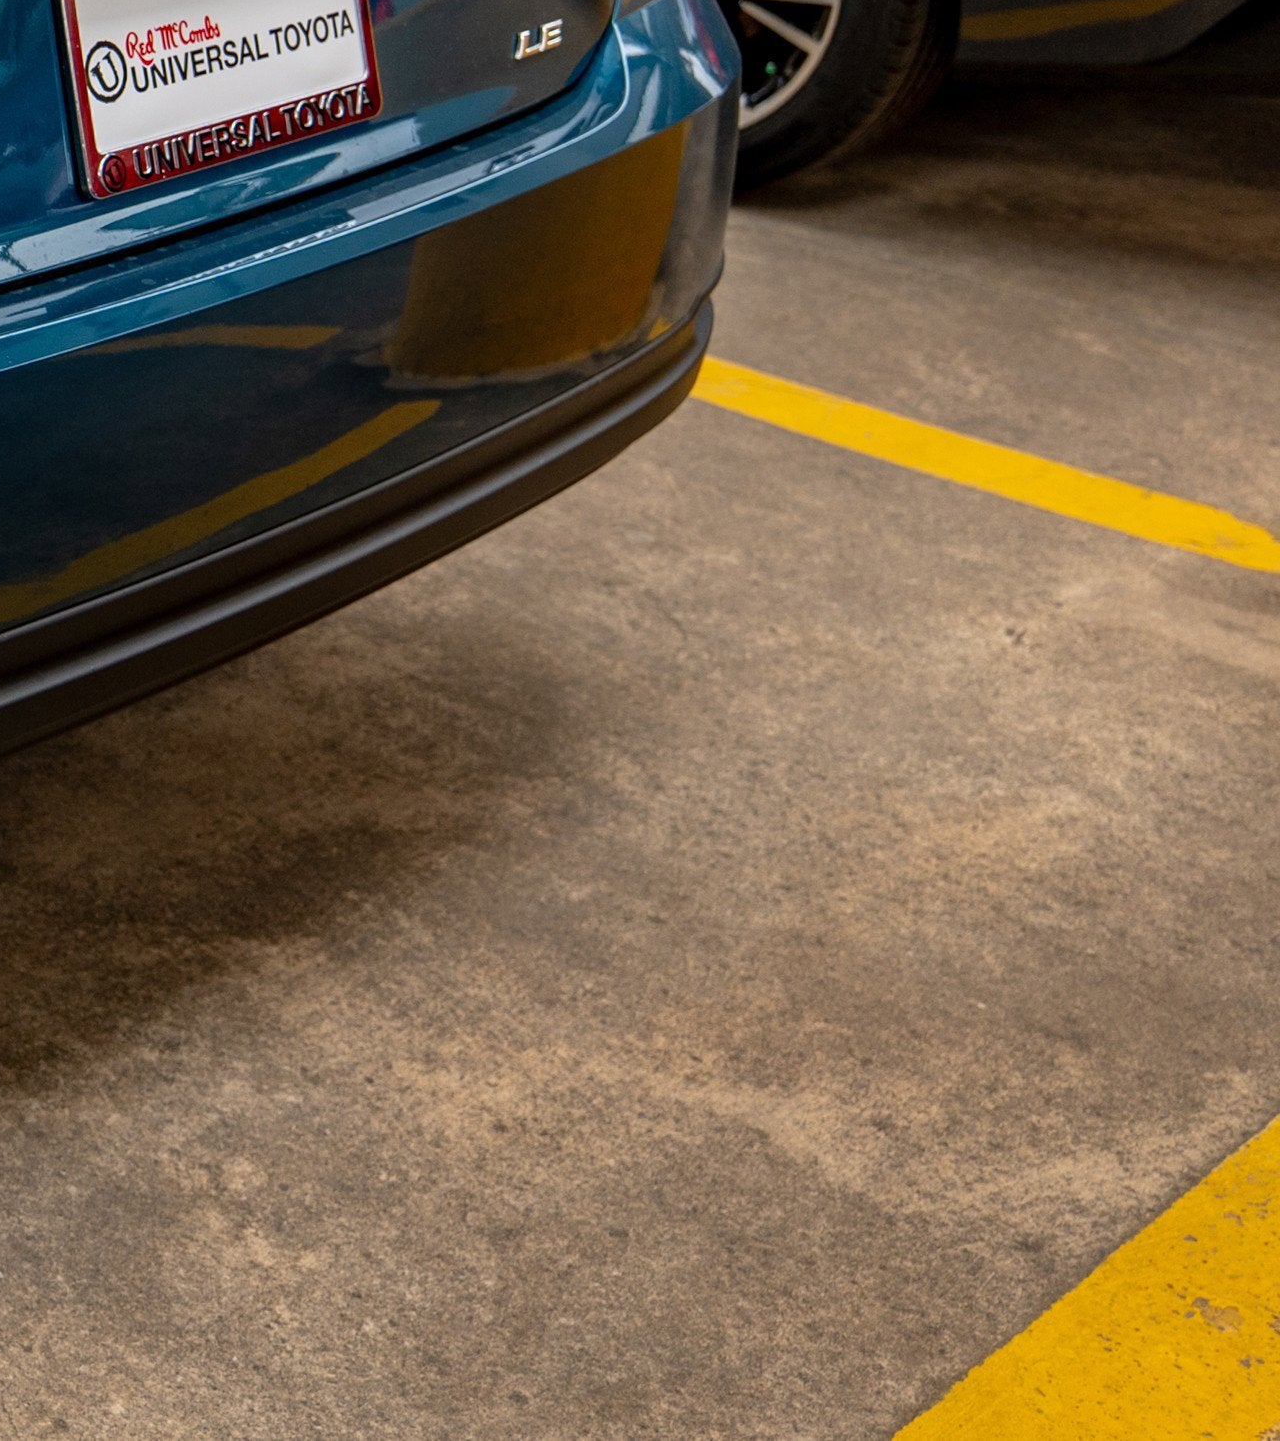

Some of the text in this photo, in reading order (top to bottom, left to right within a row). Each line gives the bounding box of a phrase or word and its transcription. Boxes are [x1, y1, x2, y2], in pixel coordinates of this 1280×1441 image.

[126, 15, 221, 66] Red McCombs
[130, 9, 355, 93] UNIVERSAL TOYOTA
[513, 18, 563, 60] LE
[131, 83, 372, 181] UNIVERSAL TOYOTA
